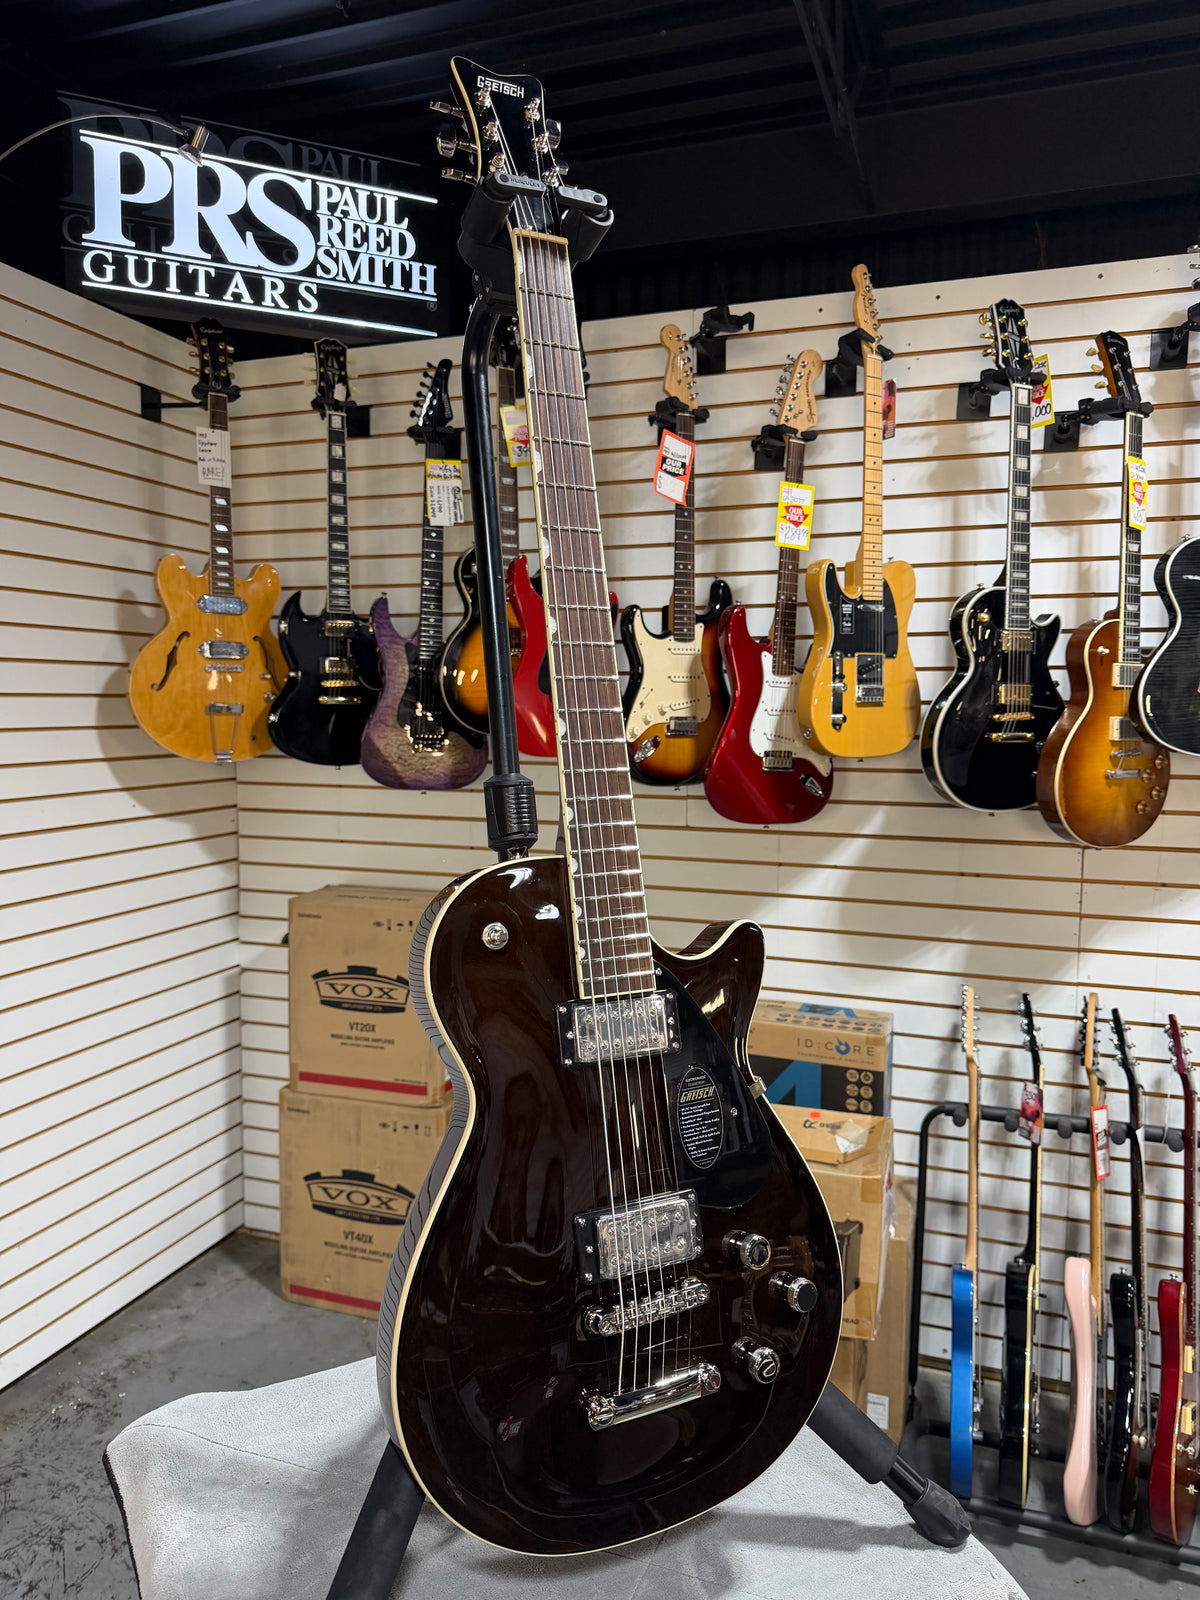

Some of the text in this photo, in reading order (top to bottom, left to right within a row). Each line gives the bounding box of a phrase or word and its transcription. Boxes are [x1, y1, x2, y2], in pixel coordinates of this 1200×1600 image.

[477, 75, 525, 99] GRETSCH
[80, 135, 316, 273] PRS
[316, 180, 409, 229] PAUL
[316, 214, 417, 258] REED
[316, 246, 438, 297] SMITH
[82, 249, 320, 313] GUITARS
[661, 463, 685, 476] PRICE
[665, 458, 682, 468] OUR
[786, 513, 806, 522] PRICE
[788, 506, 803, 516] OUR
[327, 982, 399, 1000] VOX
[348, 1021, 377, 1033] VT20X
[680, 1085, 716, 1103] GRETSCH
[320, 1186, 399, 1210] VOX
[343, 1230, 374, 1245] VT40X
